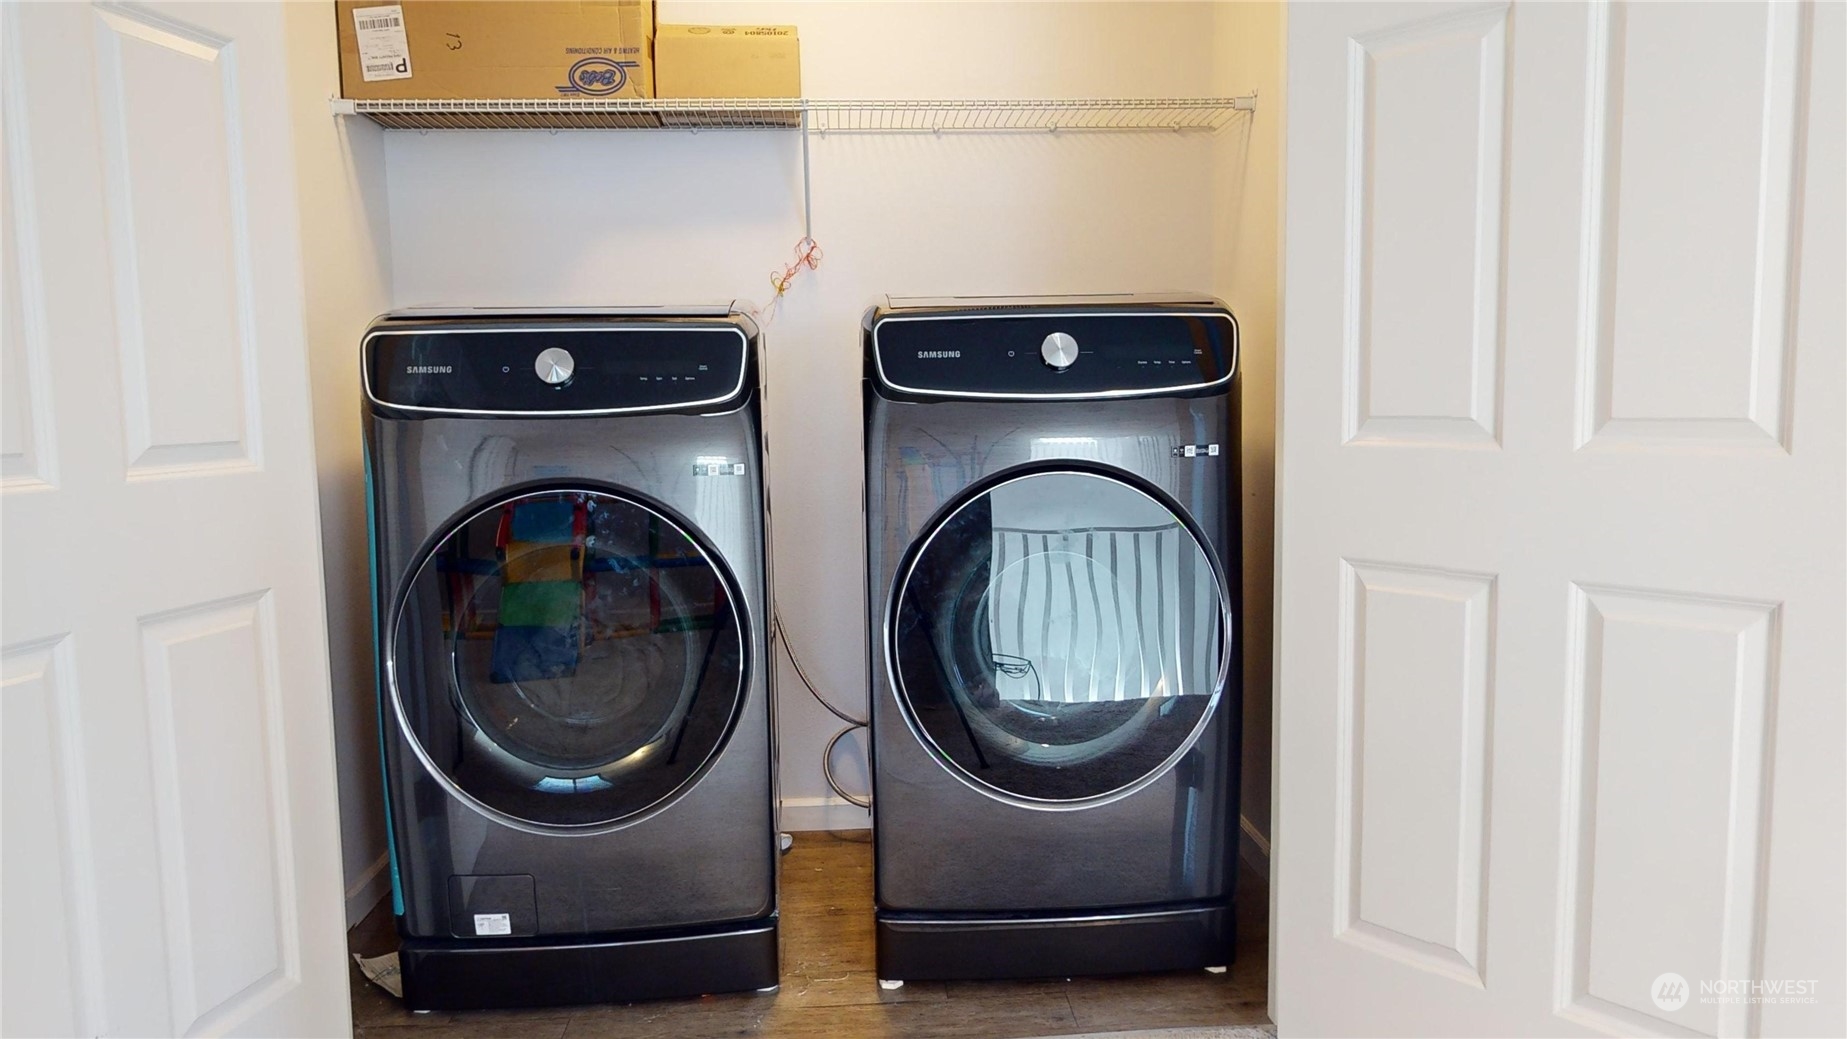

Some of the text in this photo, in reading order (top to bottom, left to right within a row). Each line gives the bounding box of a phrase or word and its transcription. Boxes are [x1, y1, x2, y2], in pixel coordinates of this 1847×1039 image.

[445, 32, 463, 51] 13
[565, 47, 603, 55] CONDITIONING
[619, 47, 640, 55] HEATING
[395, 57, 408, 74] P
[916, 350, 961, 359] SAMSUNG
[406, 365, 453, 374] SAMSUNG
